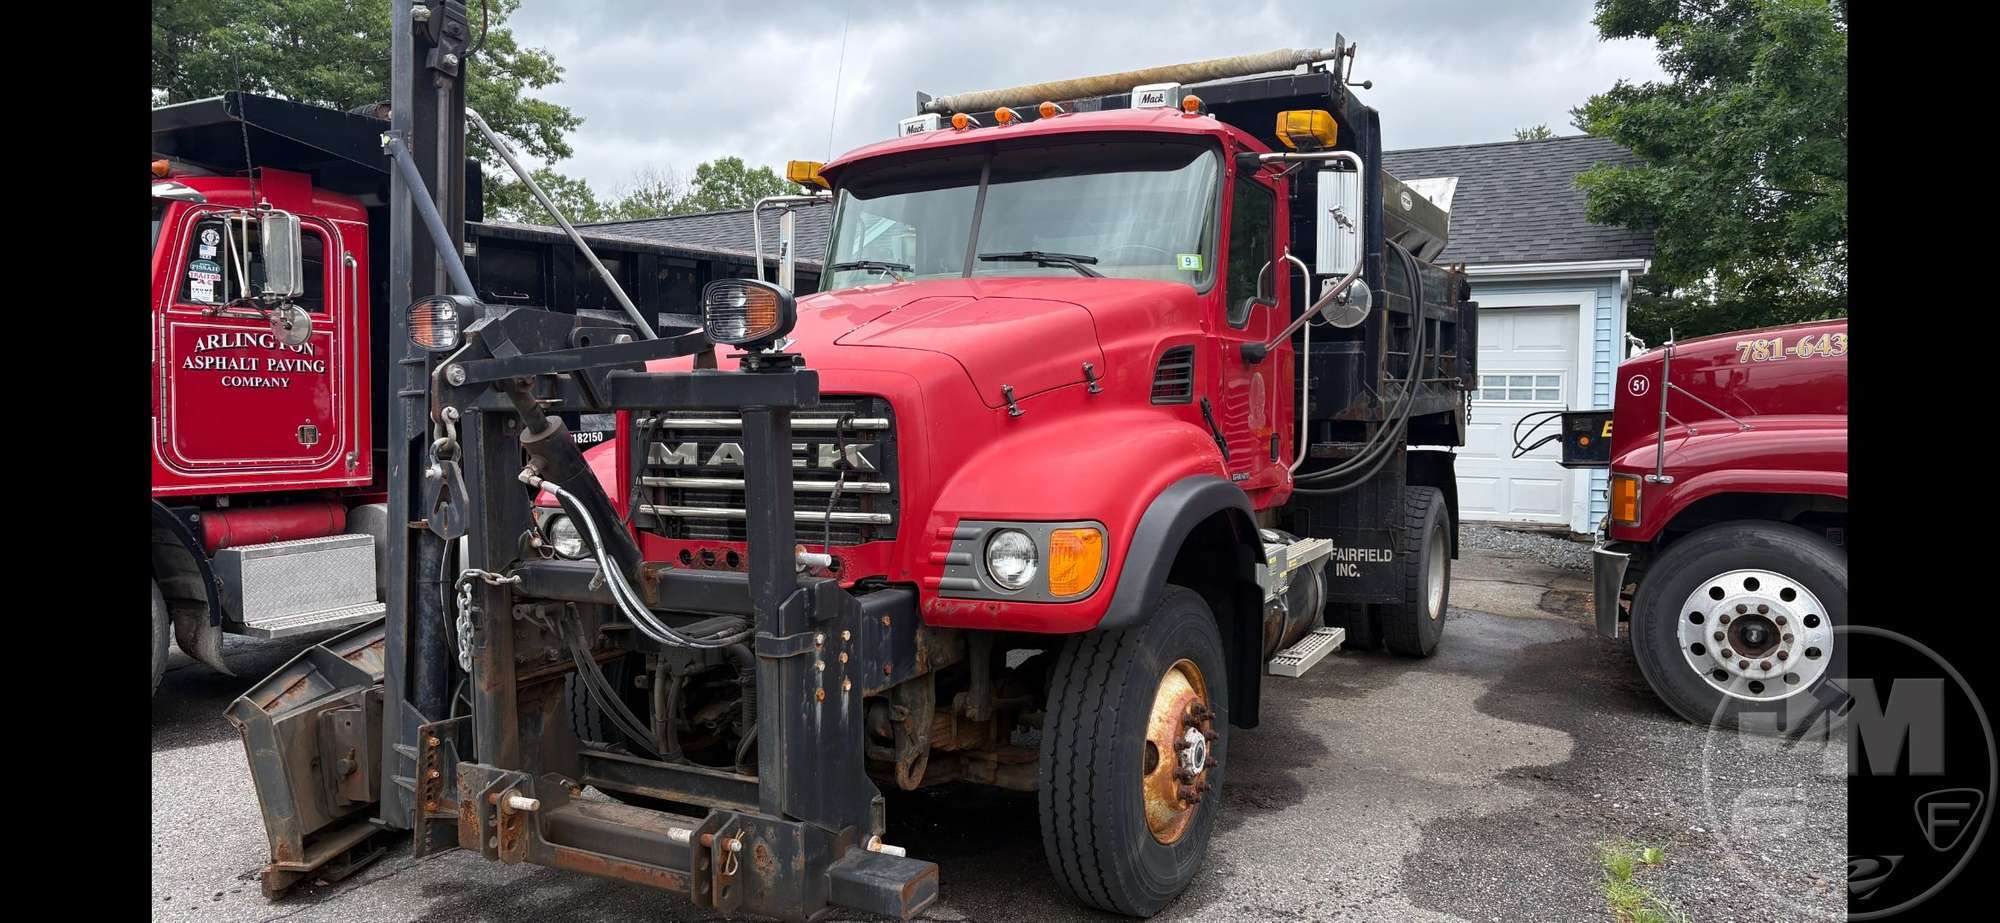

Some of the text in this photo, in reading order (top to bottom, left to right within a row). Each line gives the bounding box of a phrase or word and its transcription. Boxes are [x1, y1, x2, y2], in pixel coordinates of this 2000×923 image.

[1141, 93, 1164, 104] Mack
[906, 123, 925, 135] Mack
[1736, 333, 1848, 363] 781-643
[182, 356, 325, 373] ASPHALT PAVING
[221, 376, 290, 388] COMPANY
[1633, 380, 1645, 391] 51
[571, 432, 603, 443] 182150
[1330, 548, 1393, 562] FAIRFIELD
[1336, 563, 1361, 577] INC.
